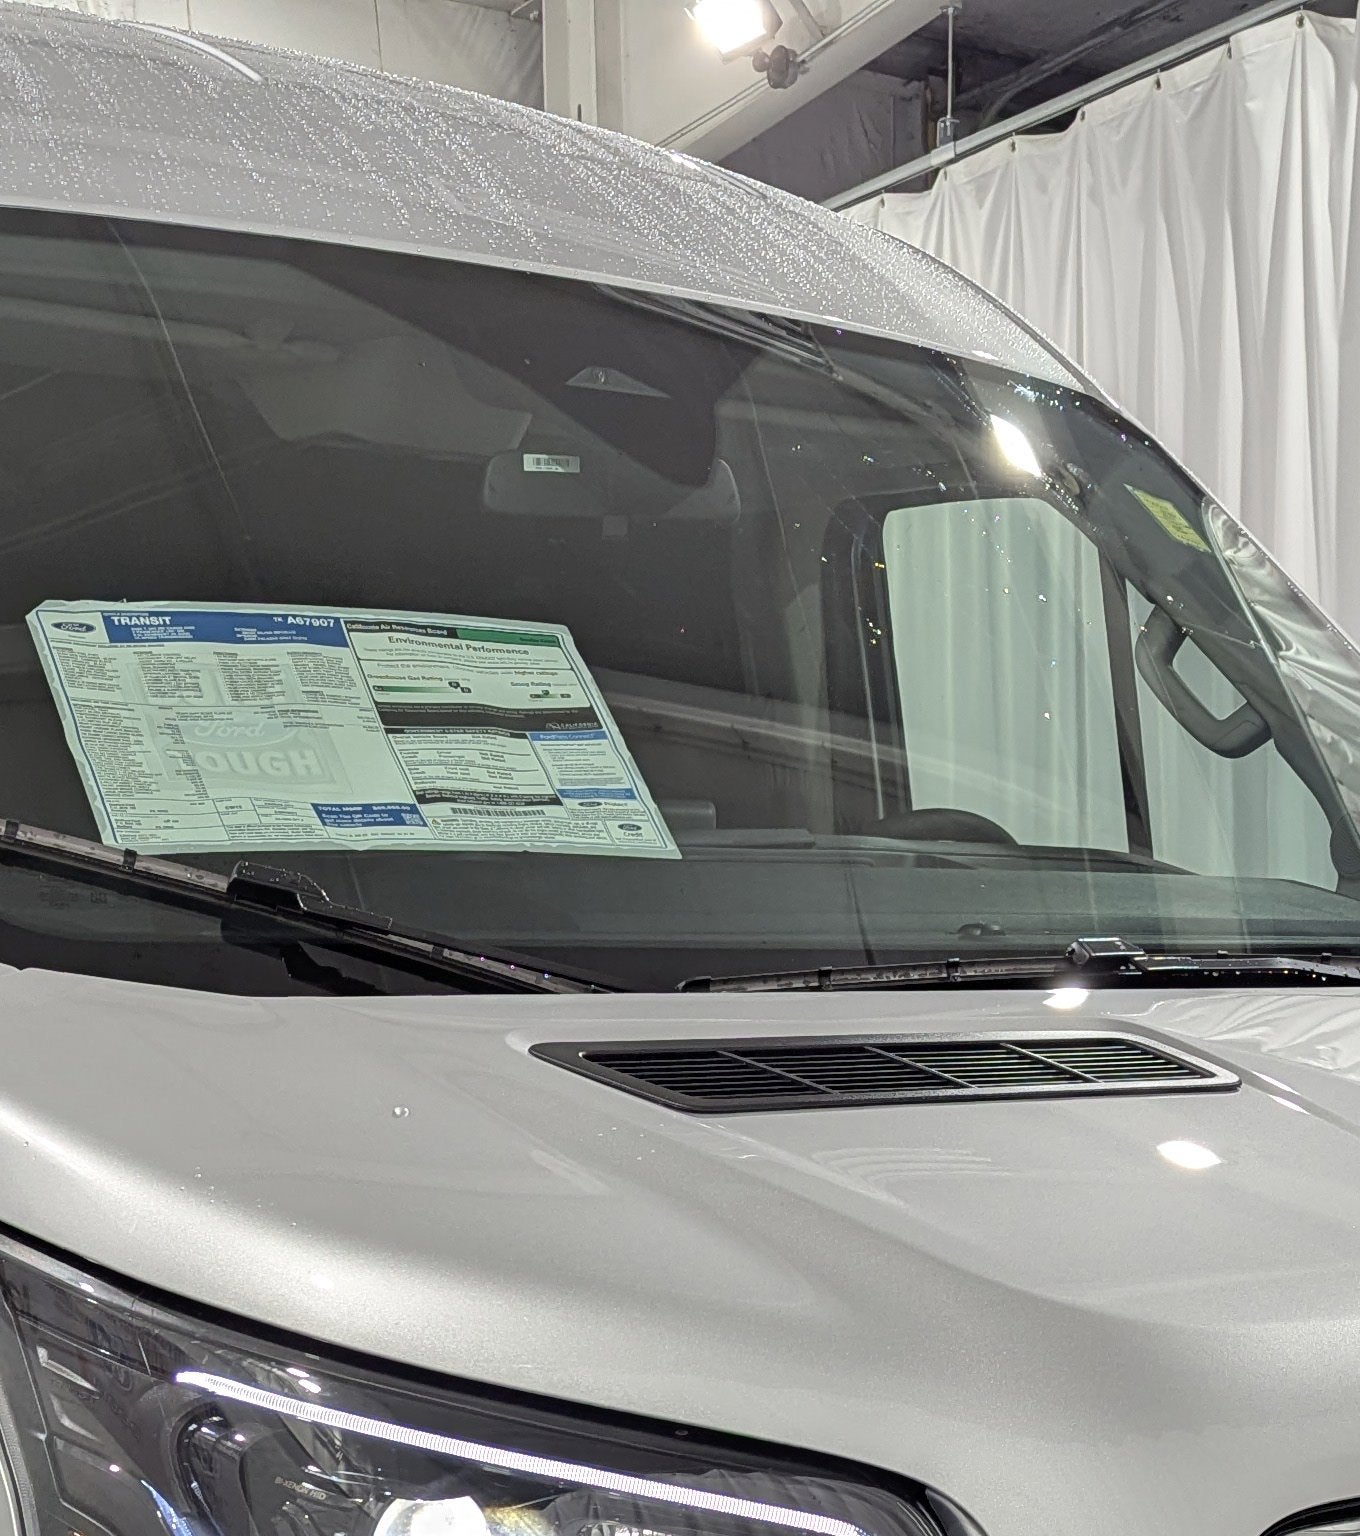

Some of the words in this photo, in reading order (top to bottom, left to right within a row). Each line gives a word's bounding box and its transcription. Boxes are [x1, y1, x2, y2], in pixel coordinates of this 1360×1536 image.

[60, 621, 87, 633] Ford
[111, 616, 172, 626] TRANSIT
[287, 616, 335, 628] A67907
[388, 635, 463, 650] Environmental
[465, 643, 530, 655] Performance
